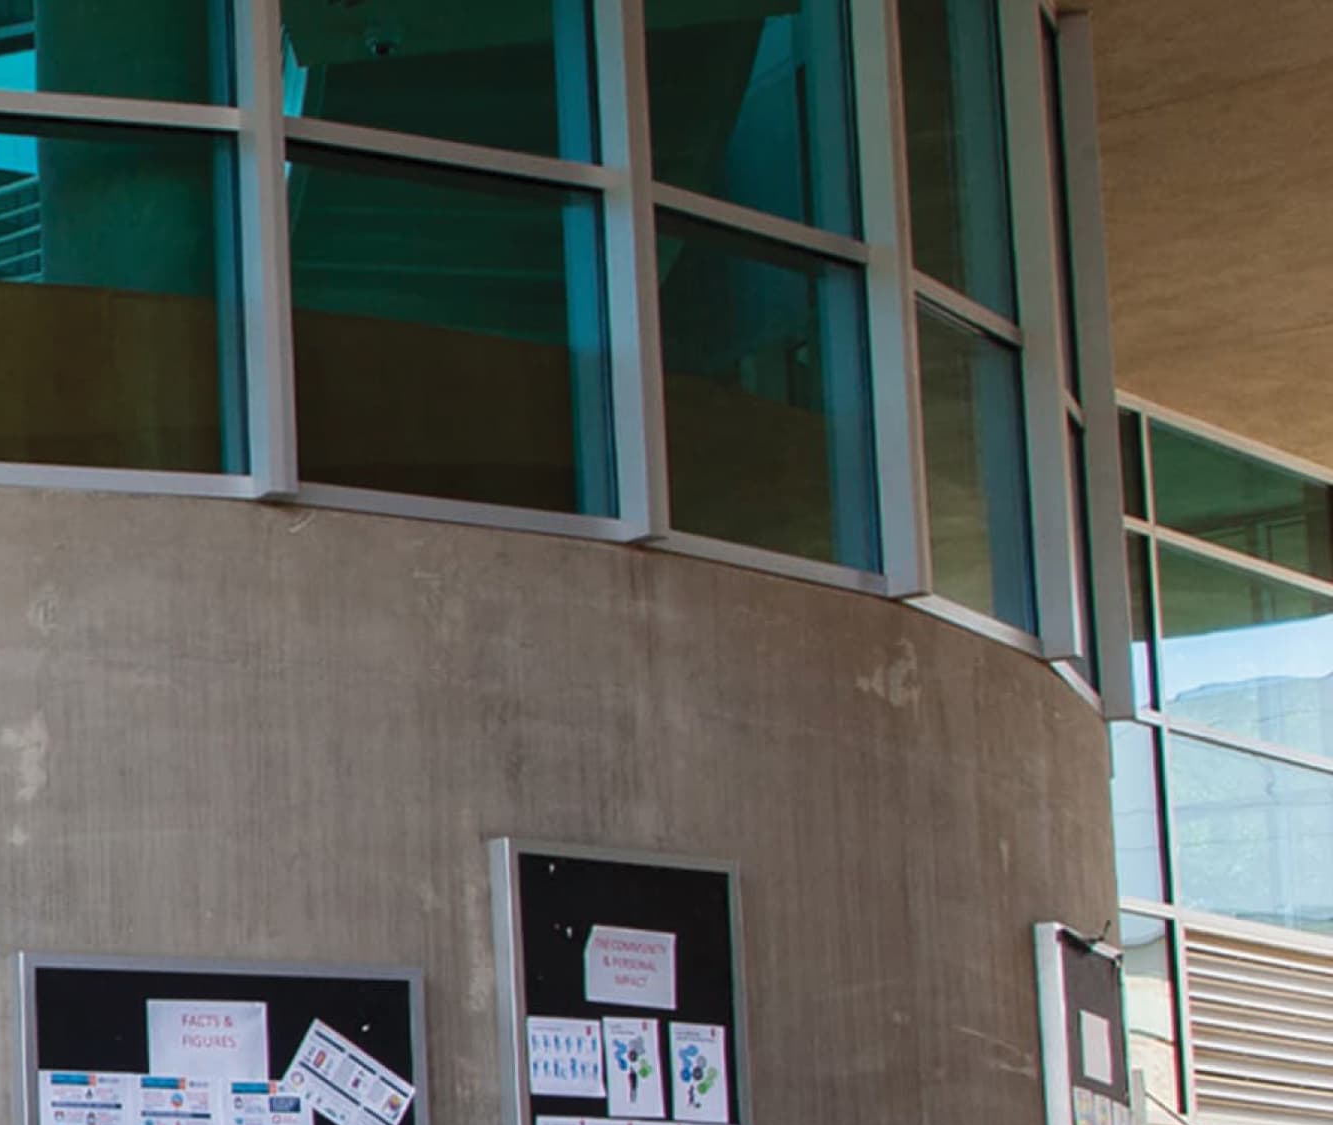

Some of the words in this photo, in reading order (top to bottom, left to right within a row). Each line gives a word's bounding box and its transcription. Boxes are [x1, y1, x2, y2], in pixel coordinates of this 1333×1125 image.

[182, 1014, 220, 1028] FACTS
[223, 1015, 233, 1028] &
[182, 1035, 237, 1049] FIGURES
